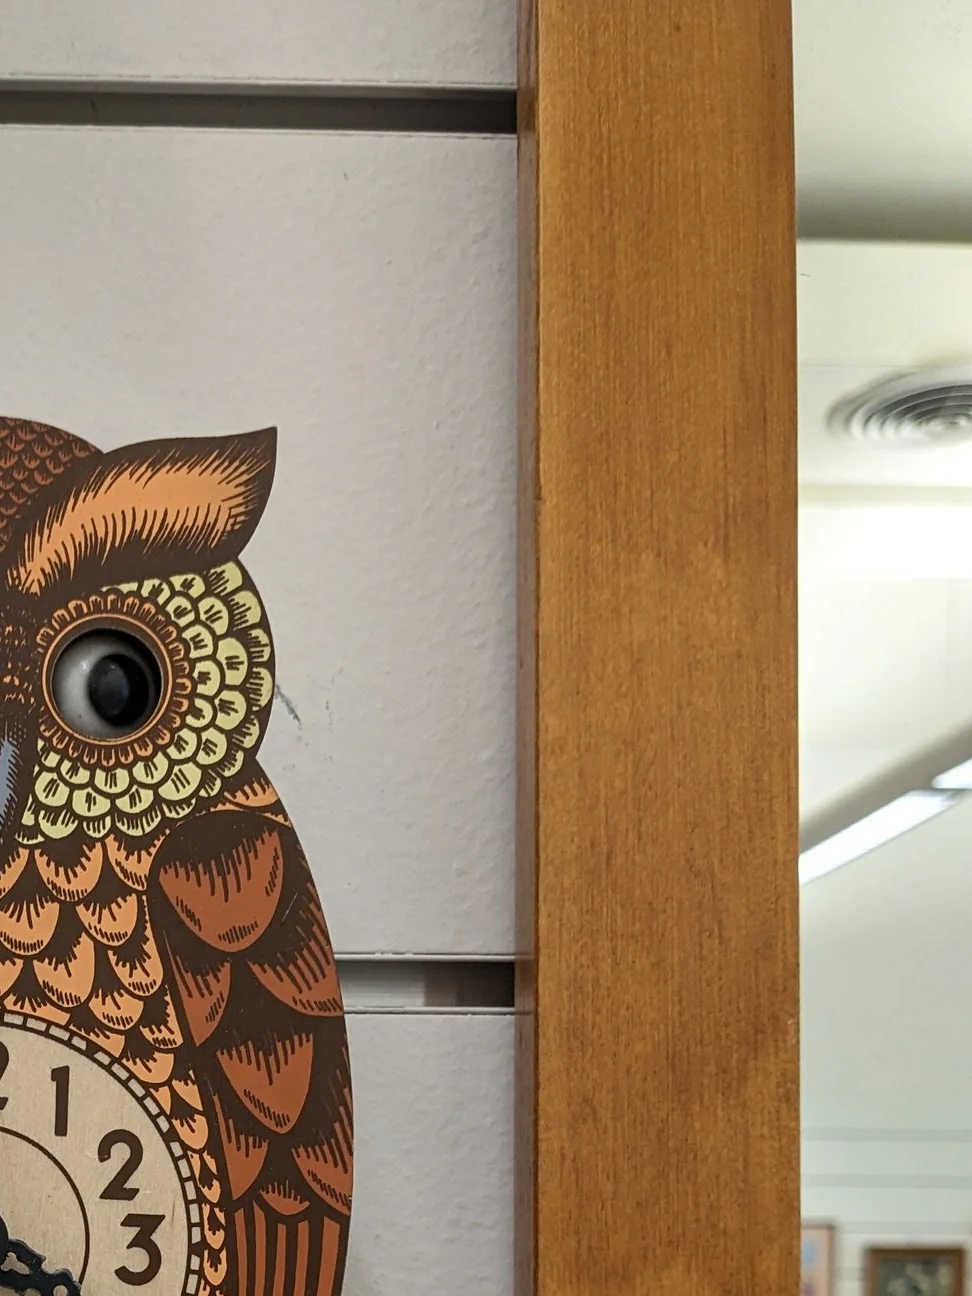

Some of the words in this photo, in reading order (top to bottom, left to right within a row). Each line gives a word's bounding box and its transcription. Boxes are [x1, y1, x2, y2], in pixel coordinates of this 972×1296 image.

[50, 1066, 70, 1137] 1
[97, 1129, 144, 1202] 2
[114, 1213, 166, 1287] 3
